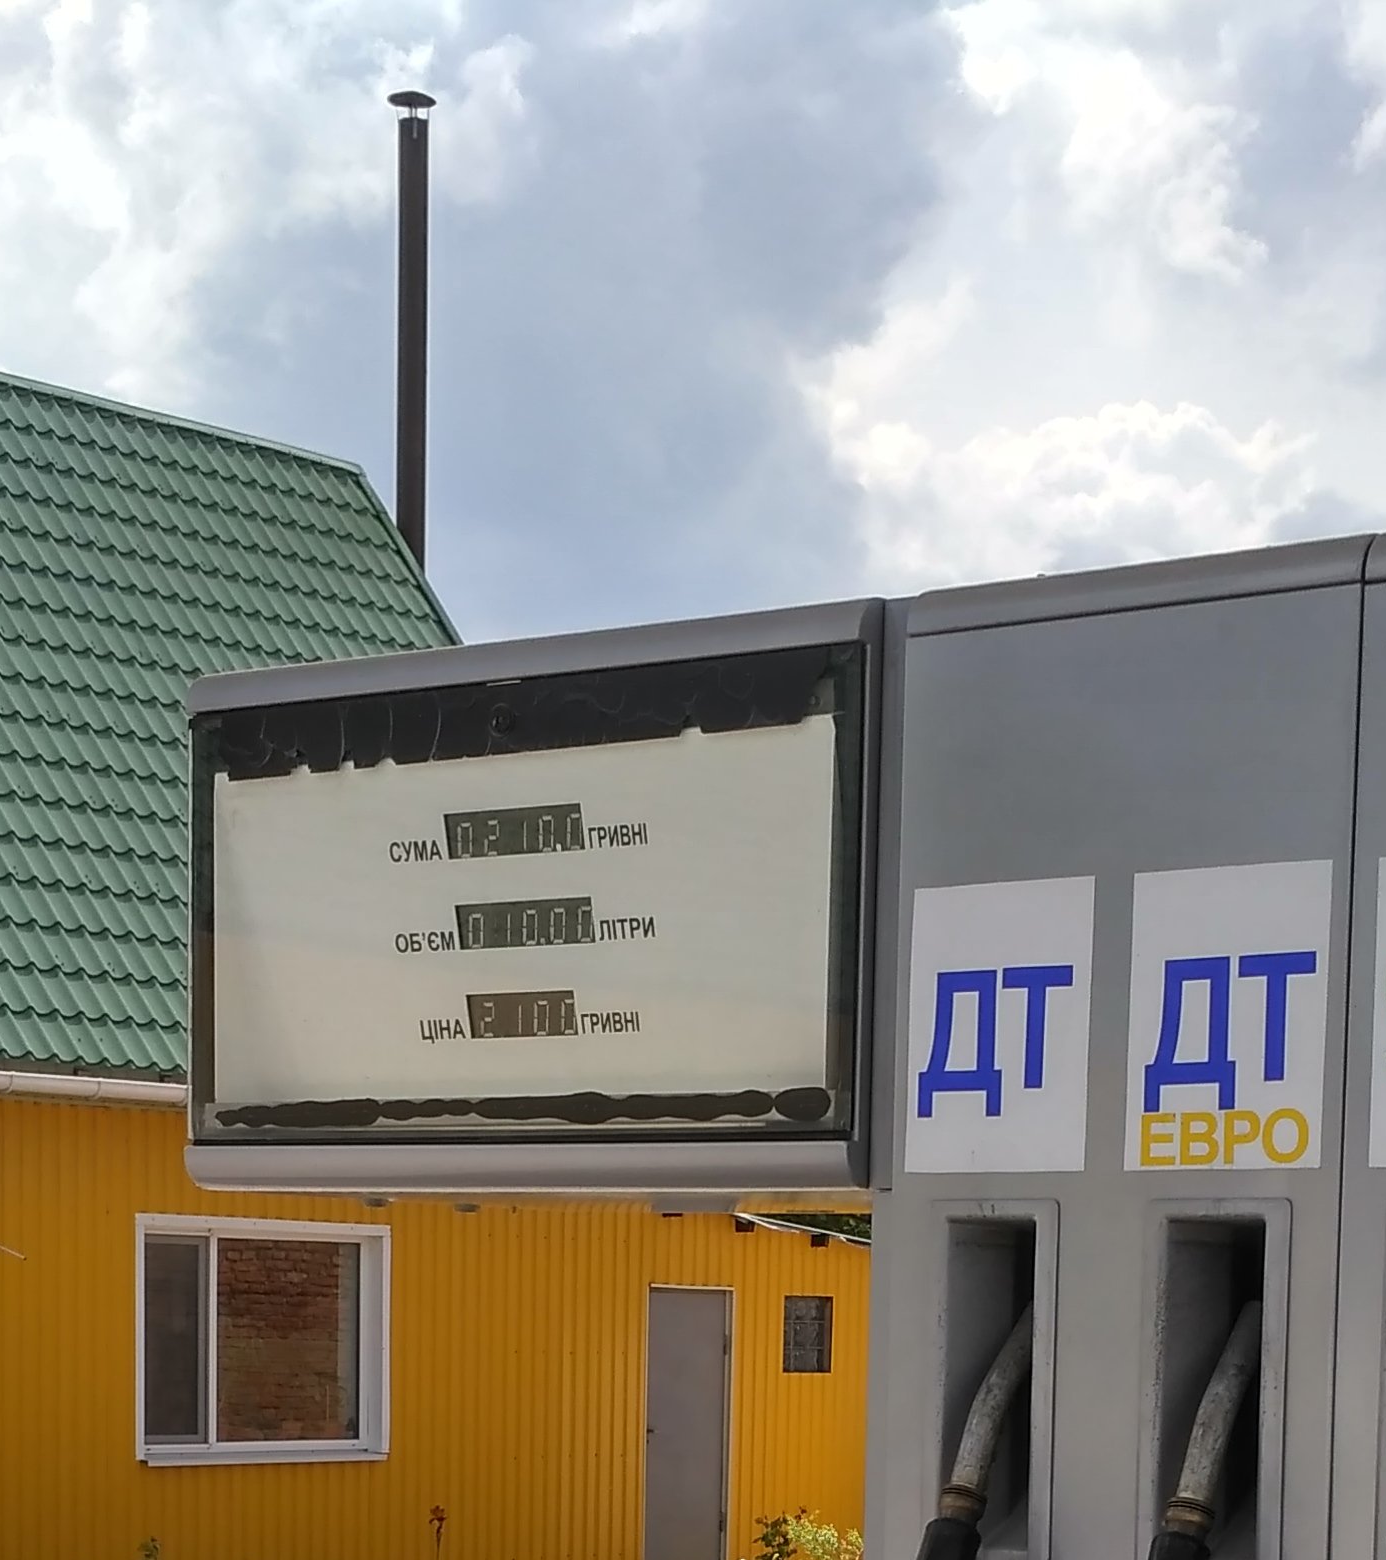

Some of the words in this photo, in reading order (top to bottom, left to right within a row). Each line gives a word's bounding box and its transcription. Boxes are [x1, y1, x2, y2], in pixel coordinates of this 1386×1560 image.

[389, 840, 442, 862] СУМА
[588, 823, 648, 849] ГРИВНІ
[395, 931, 455, 953] ОБ'ЄМ
[468, 905, 593, 949] 010.00
[599, 917, 656, 941] ЛІТРИ
[420, 1018, 466, 1044] ЦІНА
[580, 1011, 640, 1034] ГРИВНІ
[917, 965, 1074, 1118] ДТ
[1143, 950, 1317, 1113] ДТ
[1140, 1107, 1310, 1167] ЕВРО
